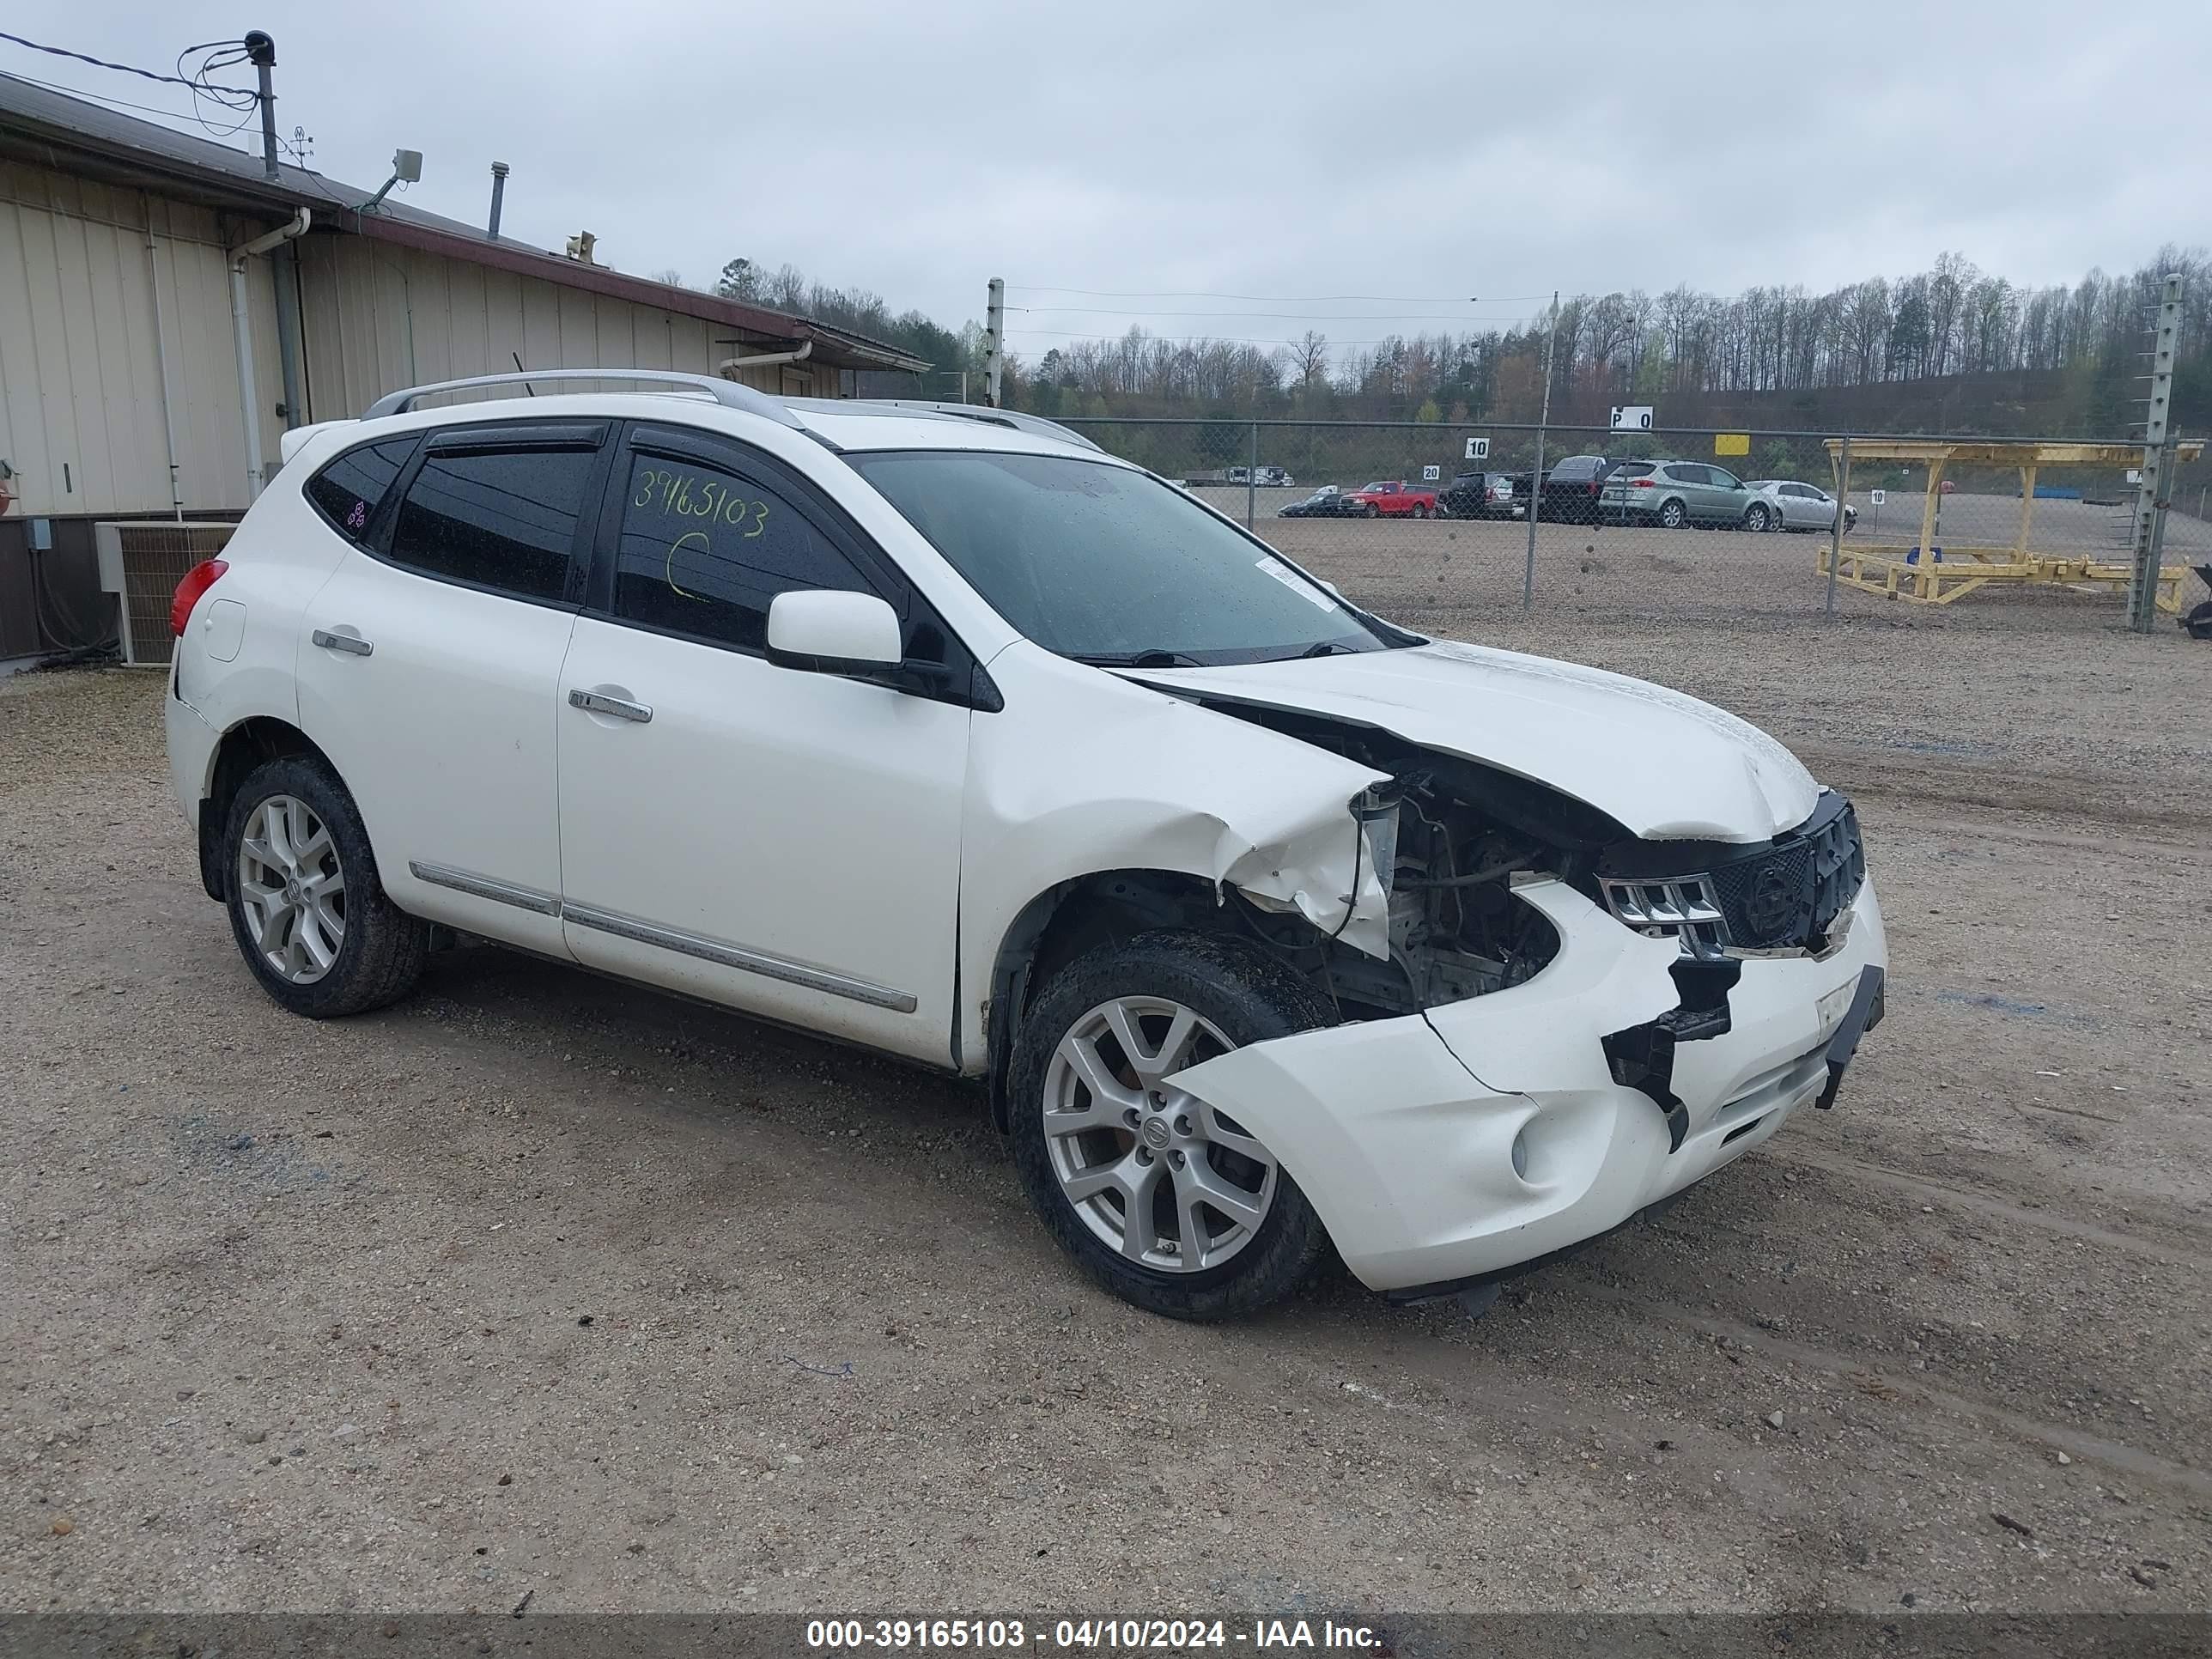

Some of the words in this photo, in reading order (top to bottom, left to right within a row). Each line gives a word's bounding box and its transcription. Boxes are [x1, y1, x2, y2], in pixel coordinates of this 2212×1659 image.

[1613, 413, 1622, 428] P
[1469, 441, 1486, 456] 10
[1425, 467, 1437, 478] 20
[1874, 491, 1883, 502] 10
[635, 471, 769, 538] 39165103
[666, 532, 711, 603] C
